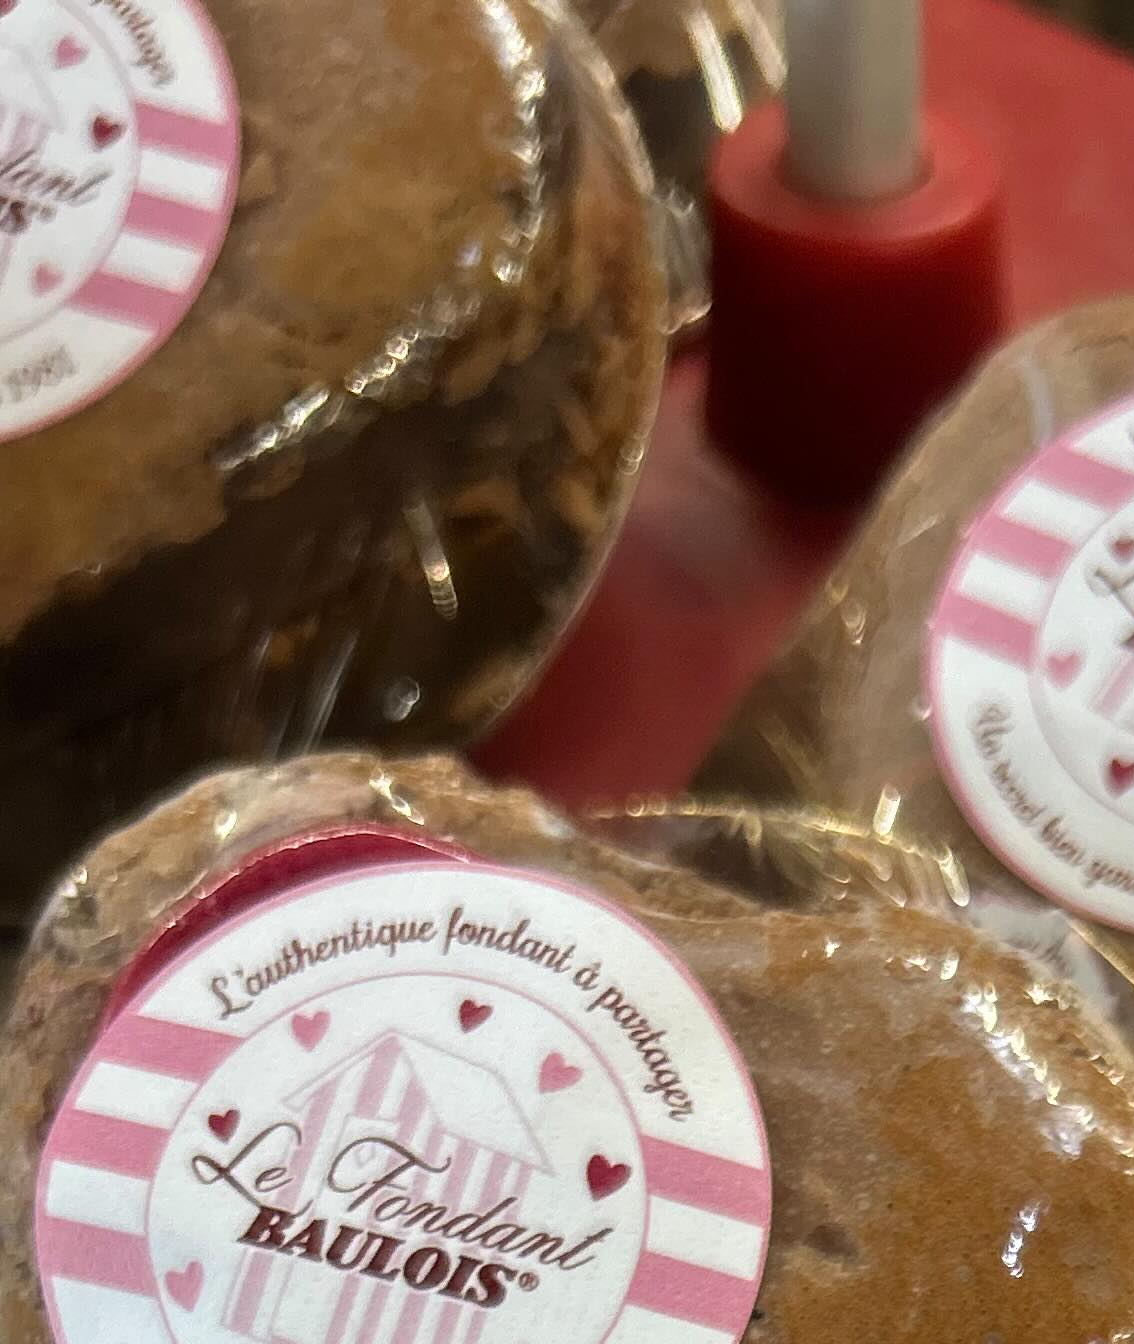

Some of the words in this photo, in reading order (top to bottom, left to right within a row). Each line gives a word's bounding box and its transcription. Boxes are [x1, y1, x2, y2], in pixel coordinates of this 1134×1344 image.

[209, 916, 436, 1019] L'authentique
[442, 906, 575, 974] fondant
[573, 960, 602, 991] à
[597, 975, 697, 1122] partager
[190, 1121, 311, 1219] Le
[327, 1136, 612, 1272] Fondant
